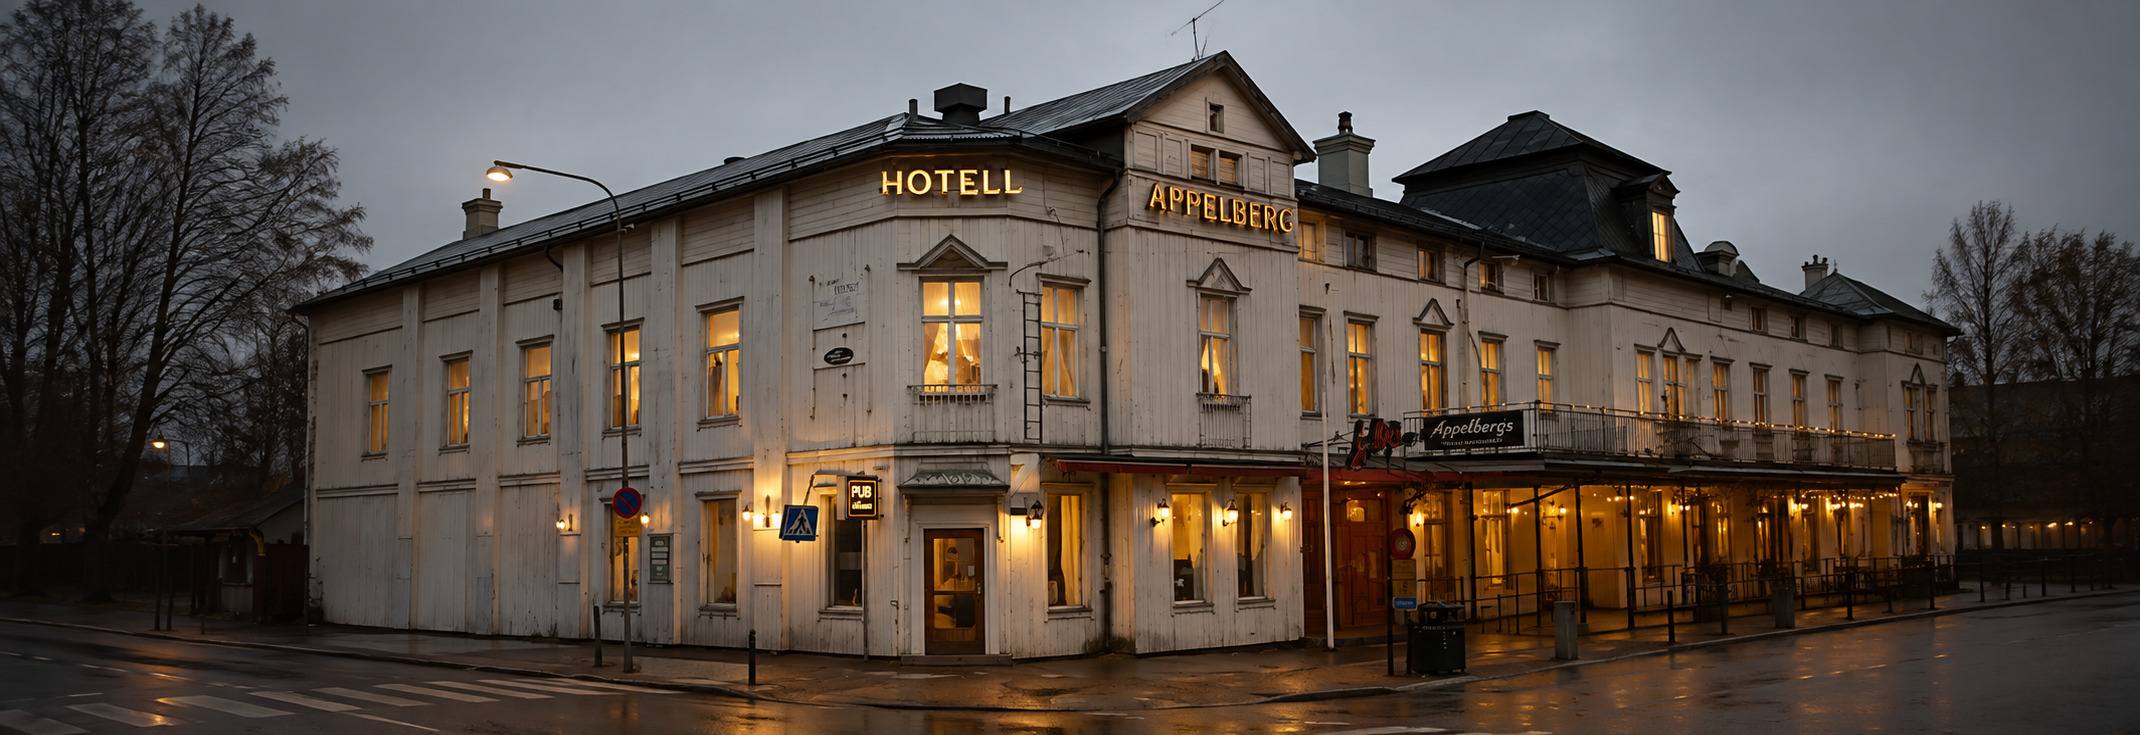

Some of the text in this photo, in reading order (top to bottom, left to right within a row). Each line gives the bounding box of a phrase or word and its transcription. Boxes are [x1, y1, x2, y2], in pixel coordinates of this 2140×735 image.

[882, 169, 1023, 195] HOTELL
[1149, 182, 1293, 232] APPELBERG
[851, 485, 872, 498] PUB
